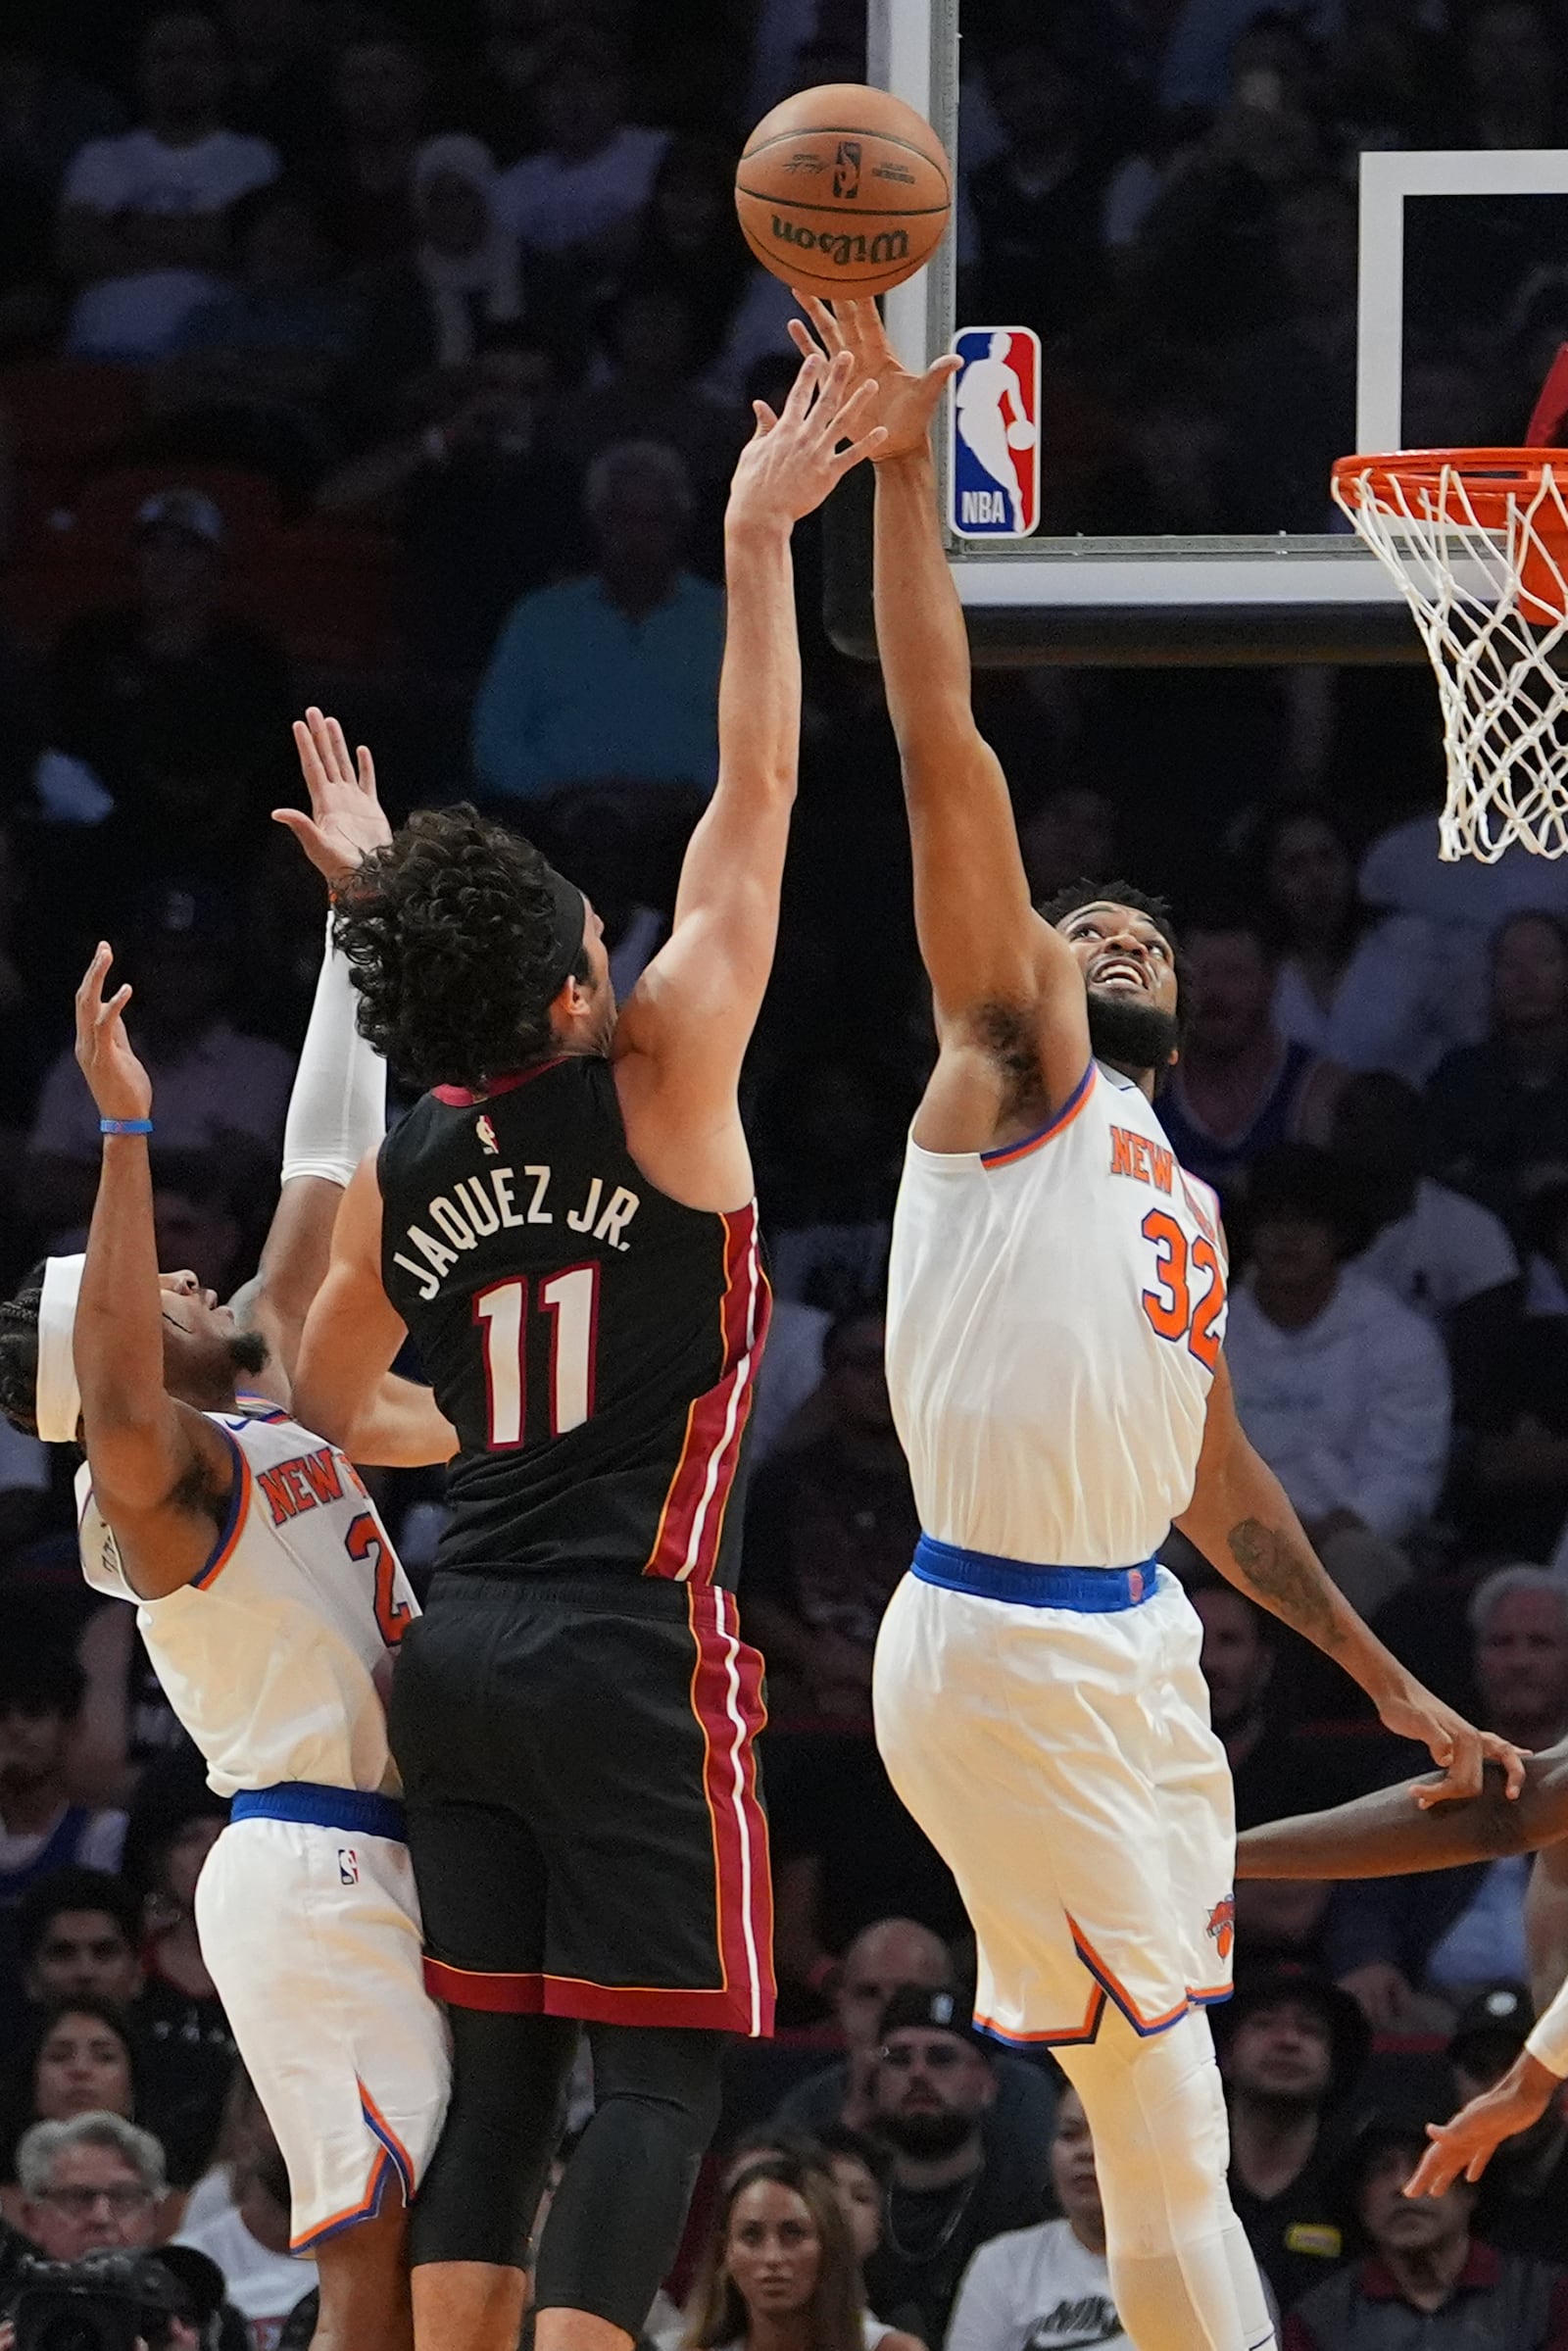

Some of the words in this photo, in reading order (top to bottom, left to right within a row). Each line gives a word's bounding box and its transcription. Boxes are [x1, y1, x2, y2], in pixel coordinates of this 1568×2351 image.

[771, 214, 908, 266] Wilson
[961, 490, 1005, 524] NBA
[1109, 1124, 1174, 1196] NEW
[393, 1165, 553, 1300] JAQUEZ
[566, 1178, 640, 1251] JR.
[1141, 1207, 1226, 1374] 32
[471, 1258, 601, 1452] 11
[255, 1446, 344, 1526] NEW
[345, 1511, 413, 1648] 2
